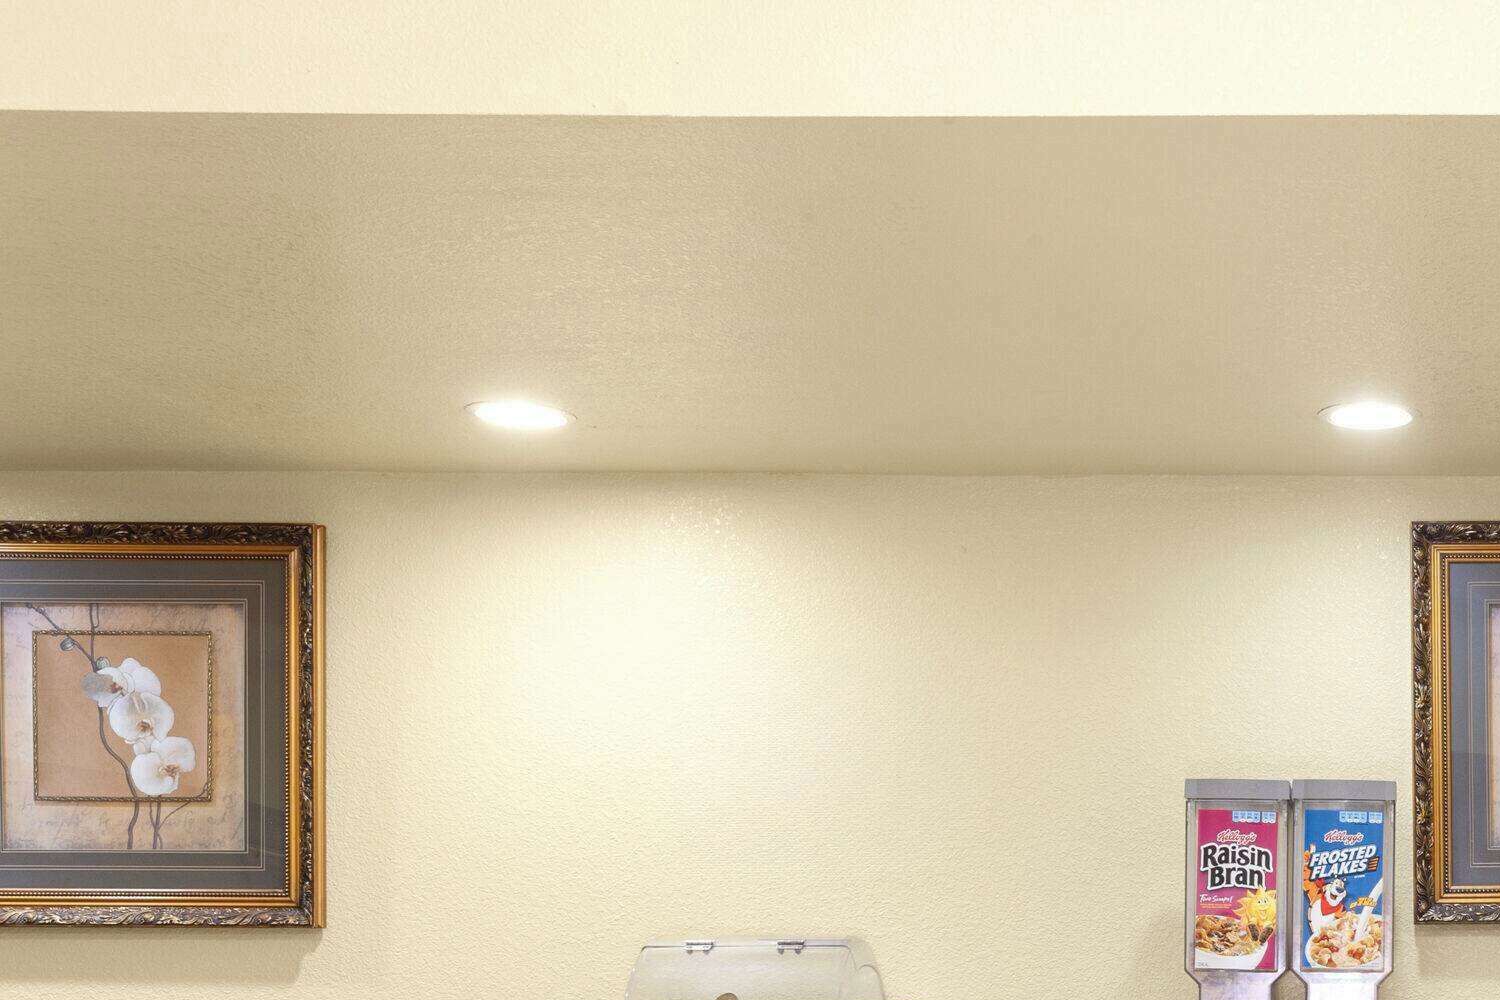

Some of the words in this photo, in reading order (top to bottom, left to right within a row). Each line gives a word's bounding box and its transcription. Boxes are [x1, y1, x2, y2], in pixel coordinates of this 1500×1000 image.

[1202, 843, 1272, 870] Raisin
[1309, 845, 1376, 867] FROSTED
[1209, 866, 1264, 889] Bran
[1311, 859, 1368, 880] FLAKES
